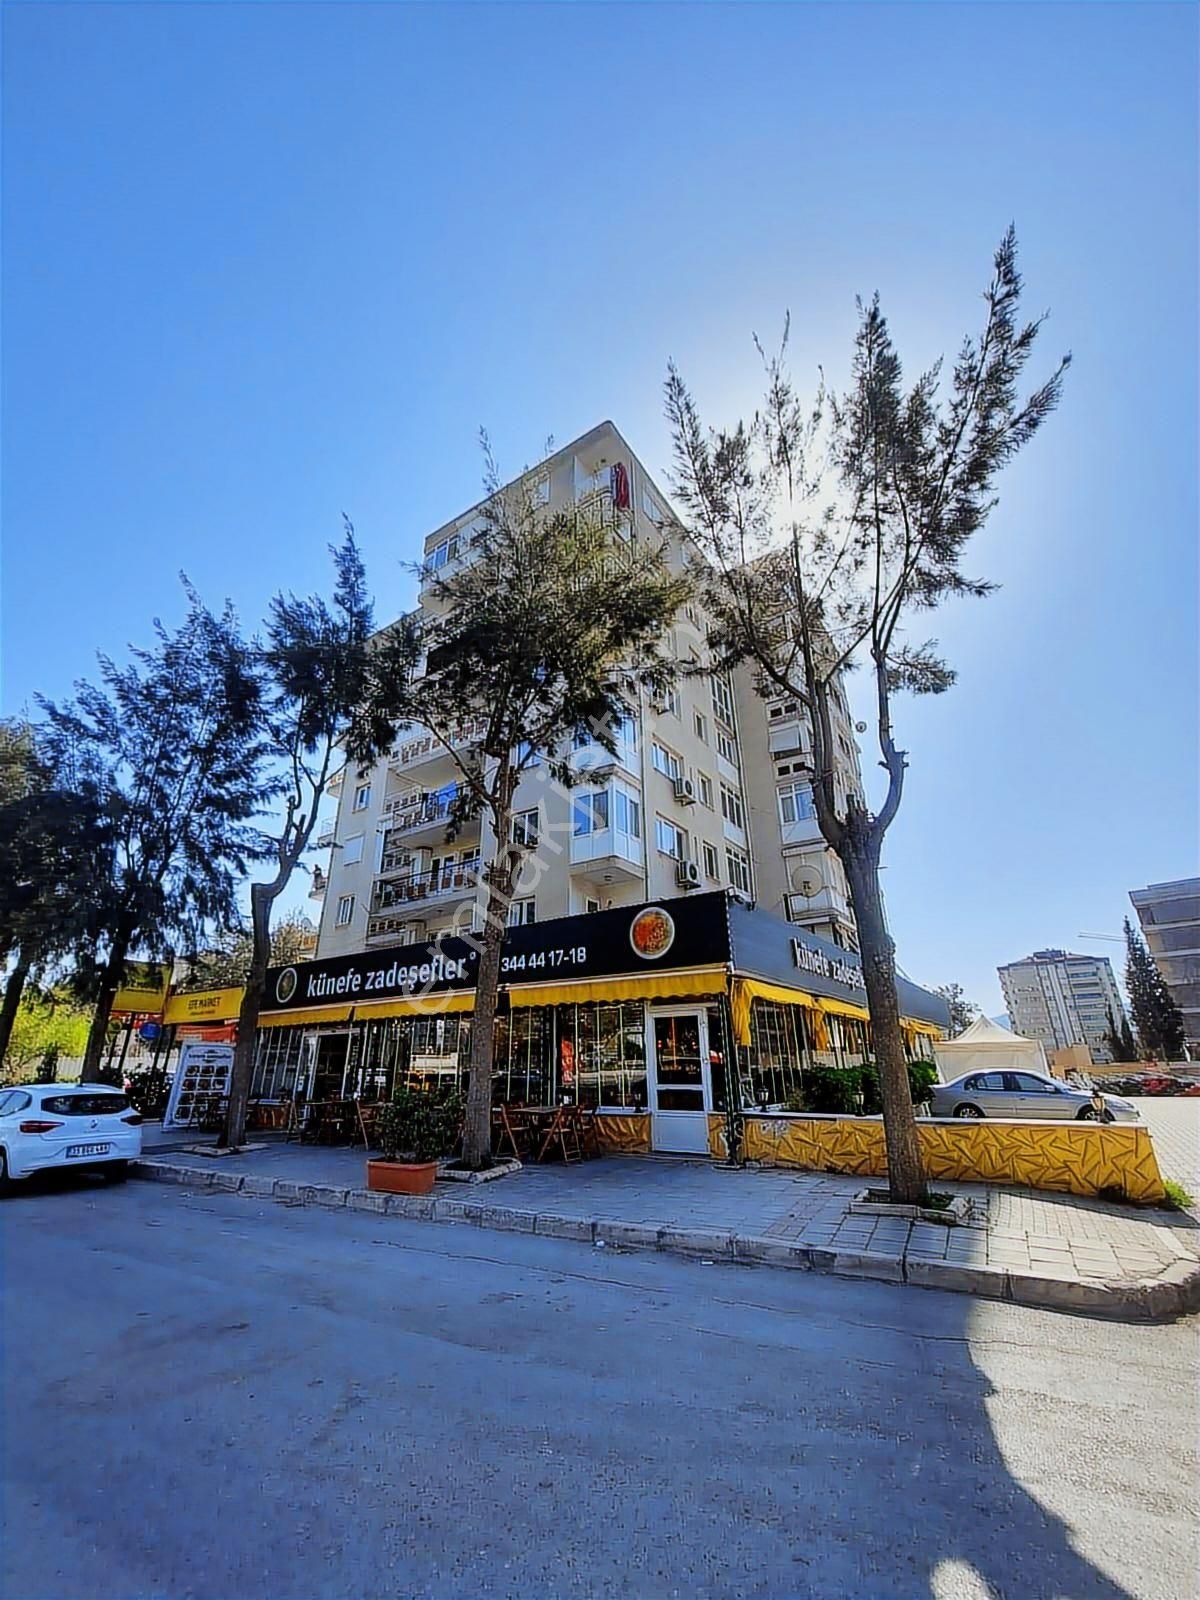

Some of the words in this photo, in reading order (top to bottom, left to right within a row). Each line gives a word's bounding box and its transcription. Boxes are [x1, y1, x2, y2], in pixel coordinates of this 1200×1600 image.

[307, 967, 362, 998] künefe
[365, 953, 467, 991] zadeşefler
[501, 953, 526, 972] 344
[528, 951, 546, 969] 44
[548, 946, 587, 967] 17-18
[793, 936, 830, 977] künefe
